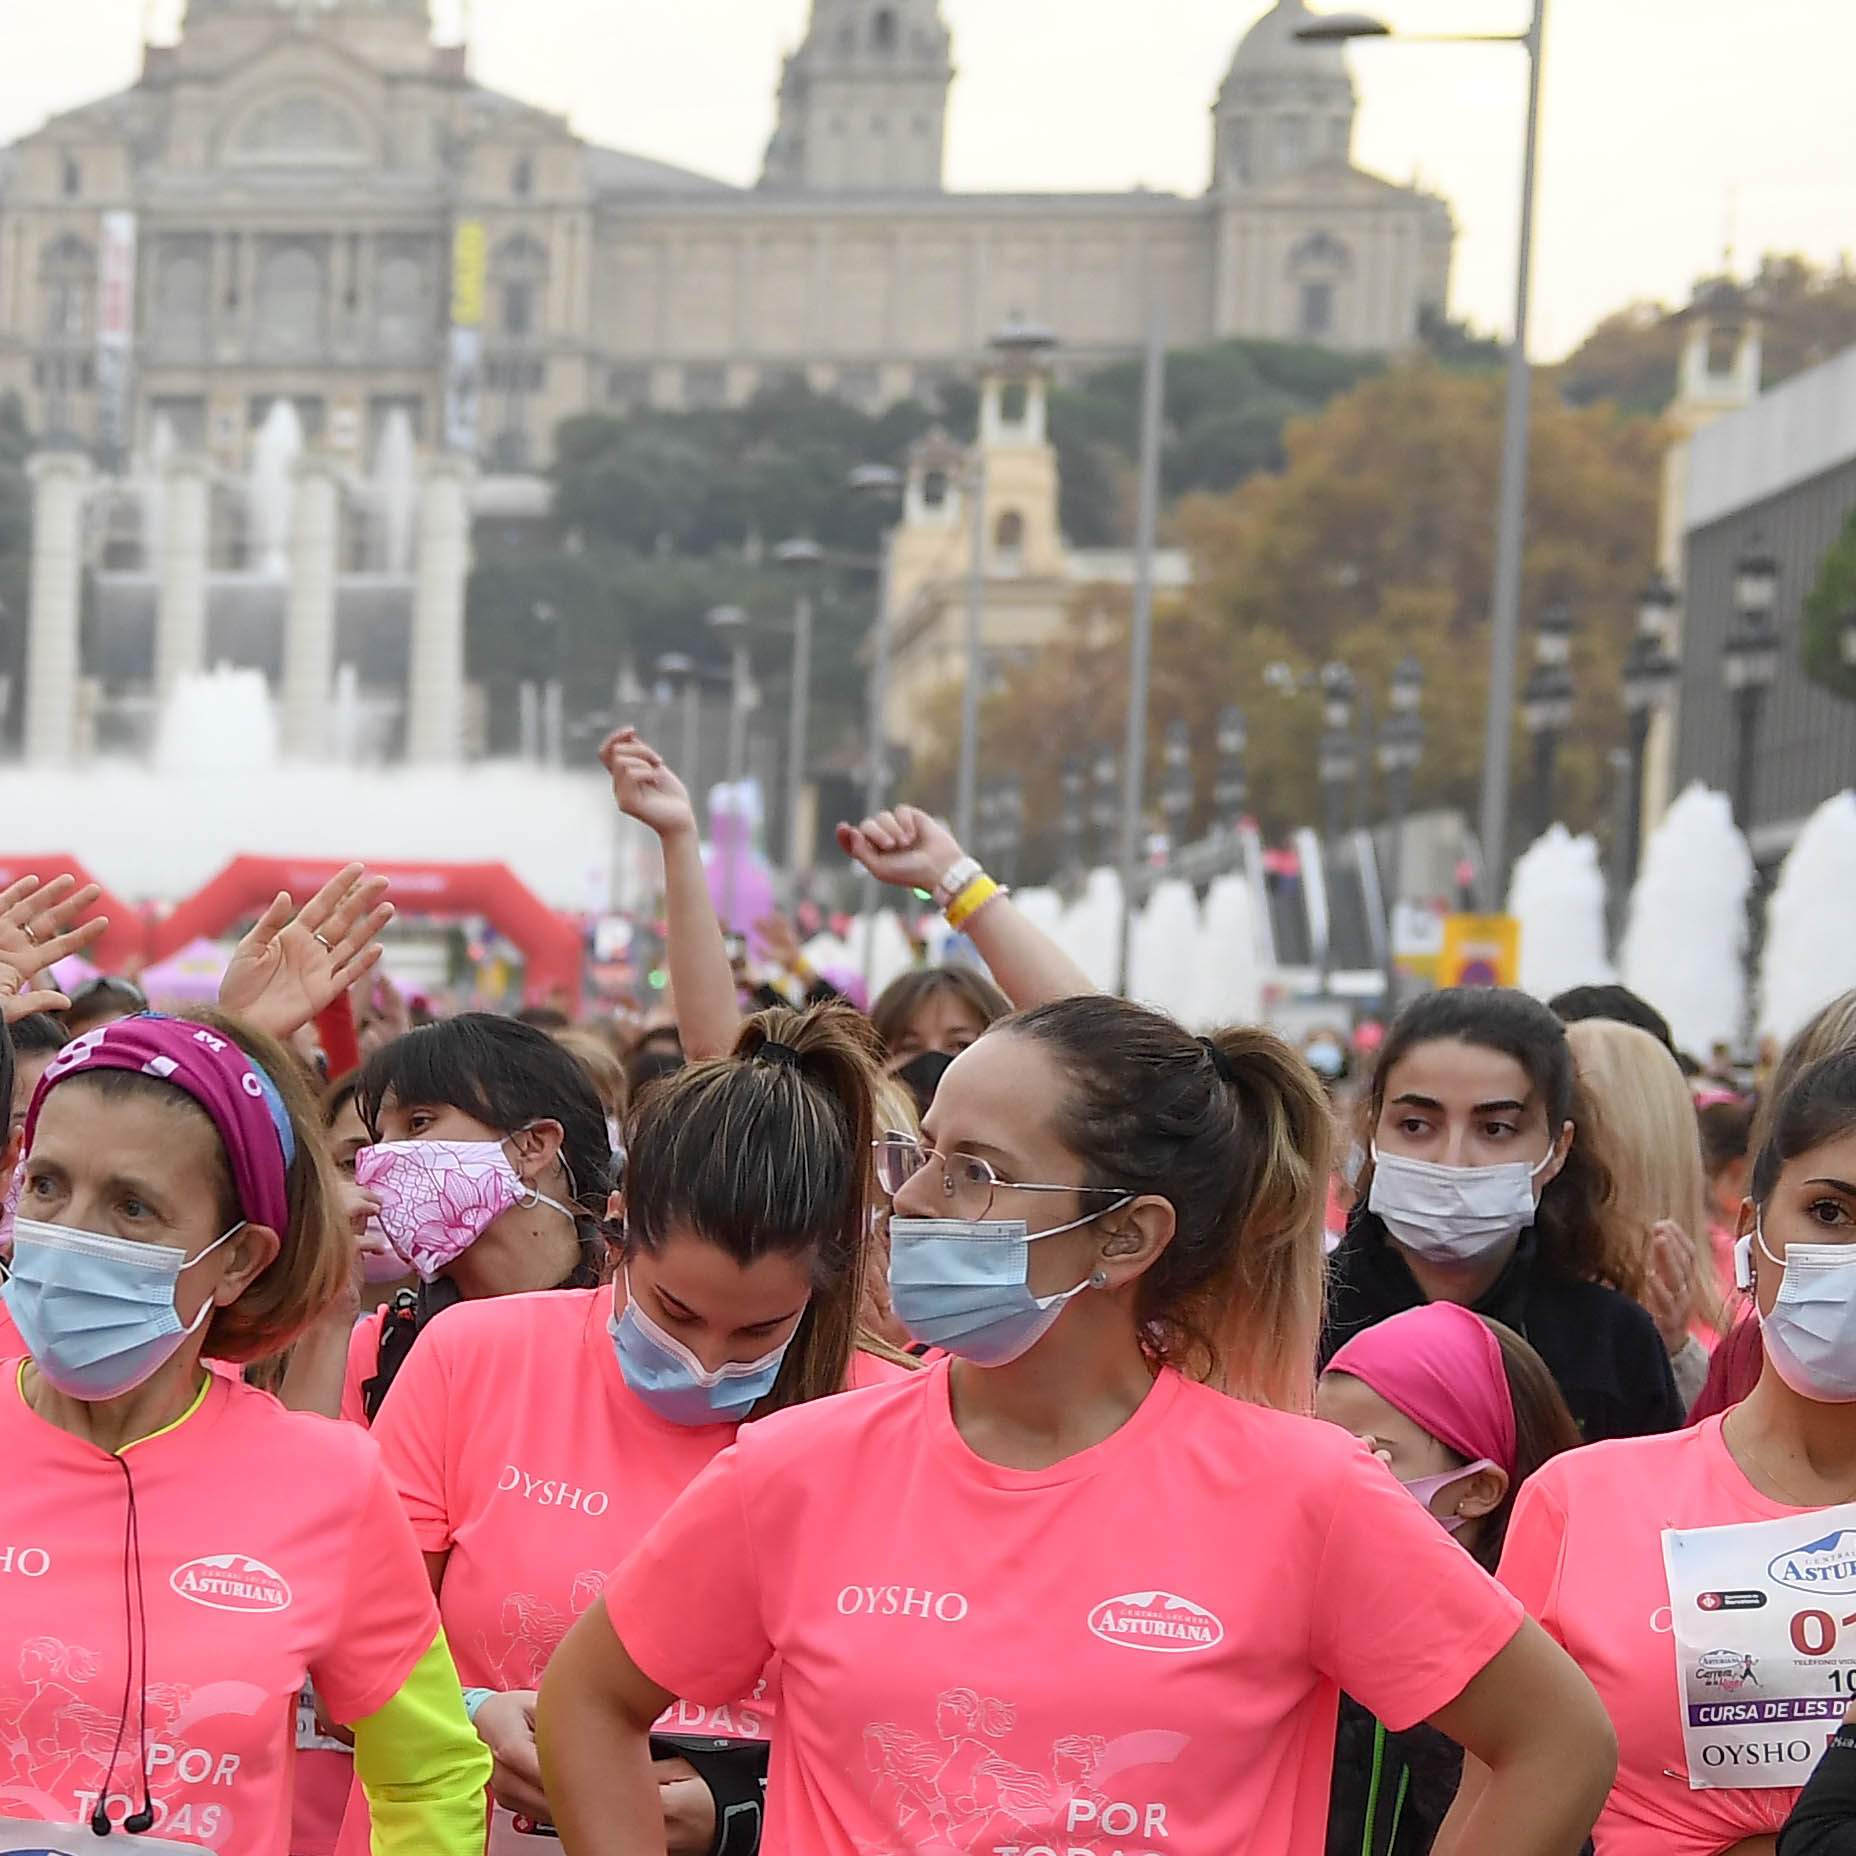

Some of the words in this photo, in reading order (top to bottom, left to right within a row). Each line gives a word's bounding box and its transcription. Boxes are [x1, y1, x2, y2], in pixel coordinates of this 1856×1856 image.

[178, 1569, 285, 1608] ASTURIANA
[837, 1585, 969, 1622] OYSHO
[1097, 1608, 1213, 1643] ASTURIANA
[1699, 1702, 1759, 1722] CURSA
[1764, 1702, 1788, 1719] DE
[1793, 1700, 1829, 1717] LES
[144, 1743, 242, 1787] POR
[1702, 1740, 1811, 1767] OYSHO
[1066, 1798, 1169, 1838] POR
